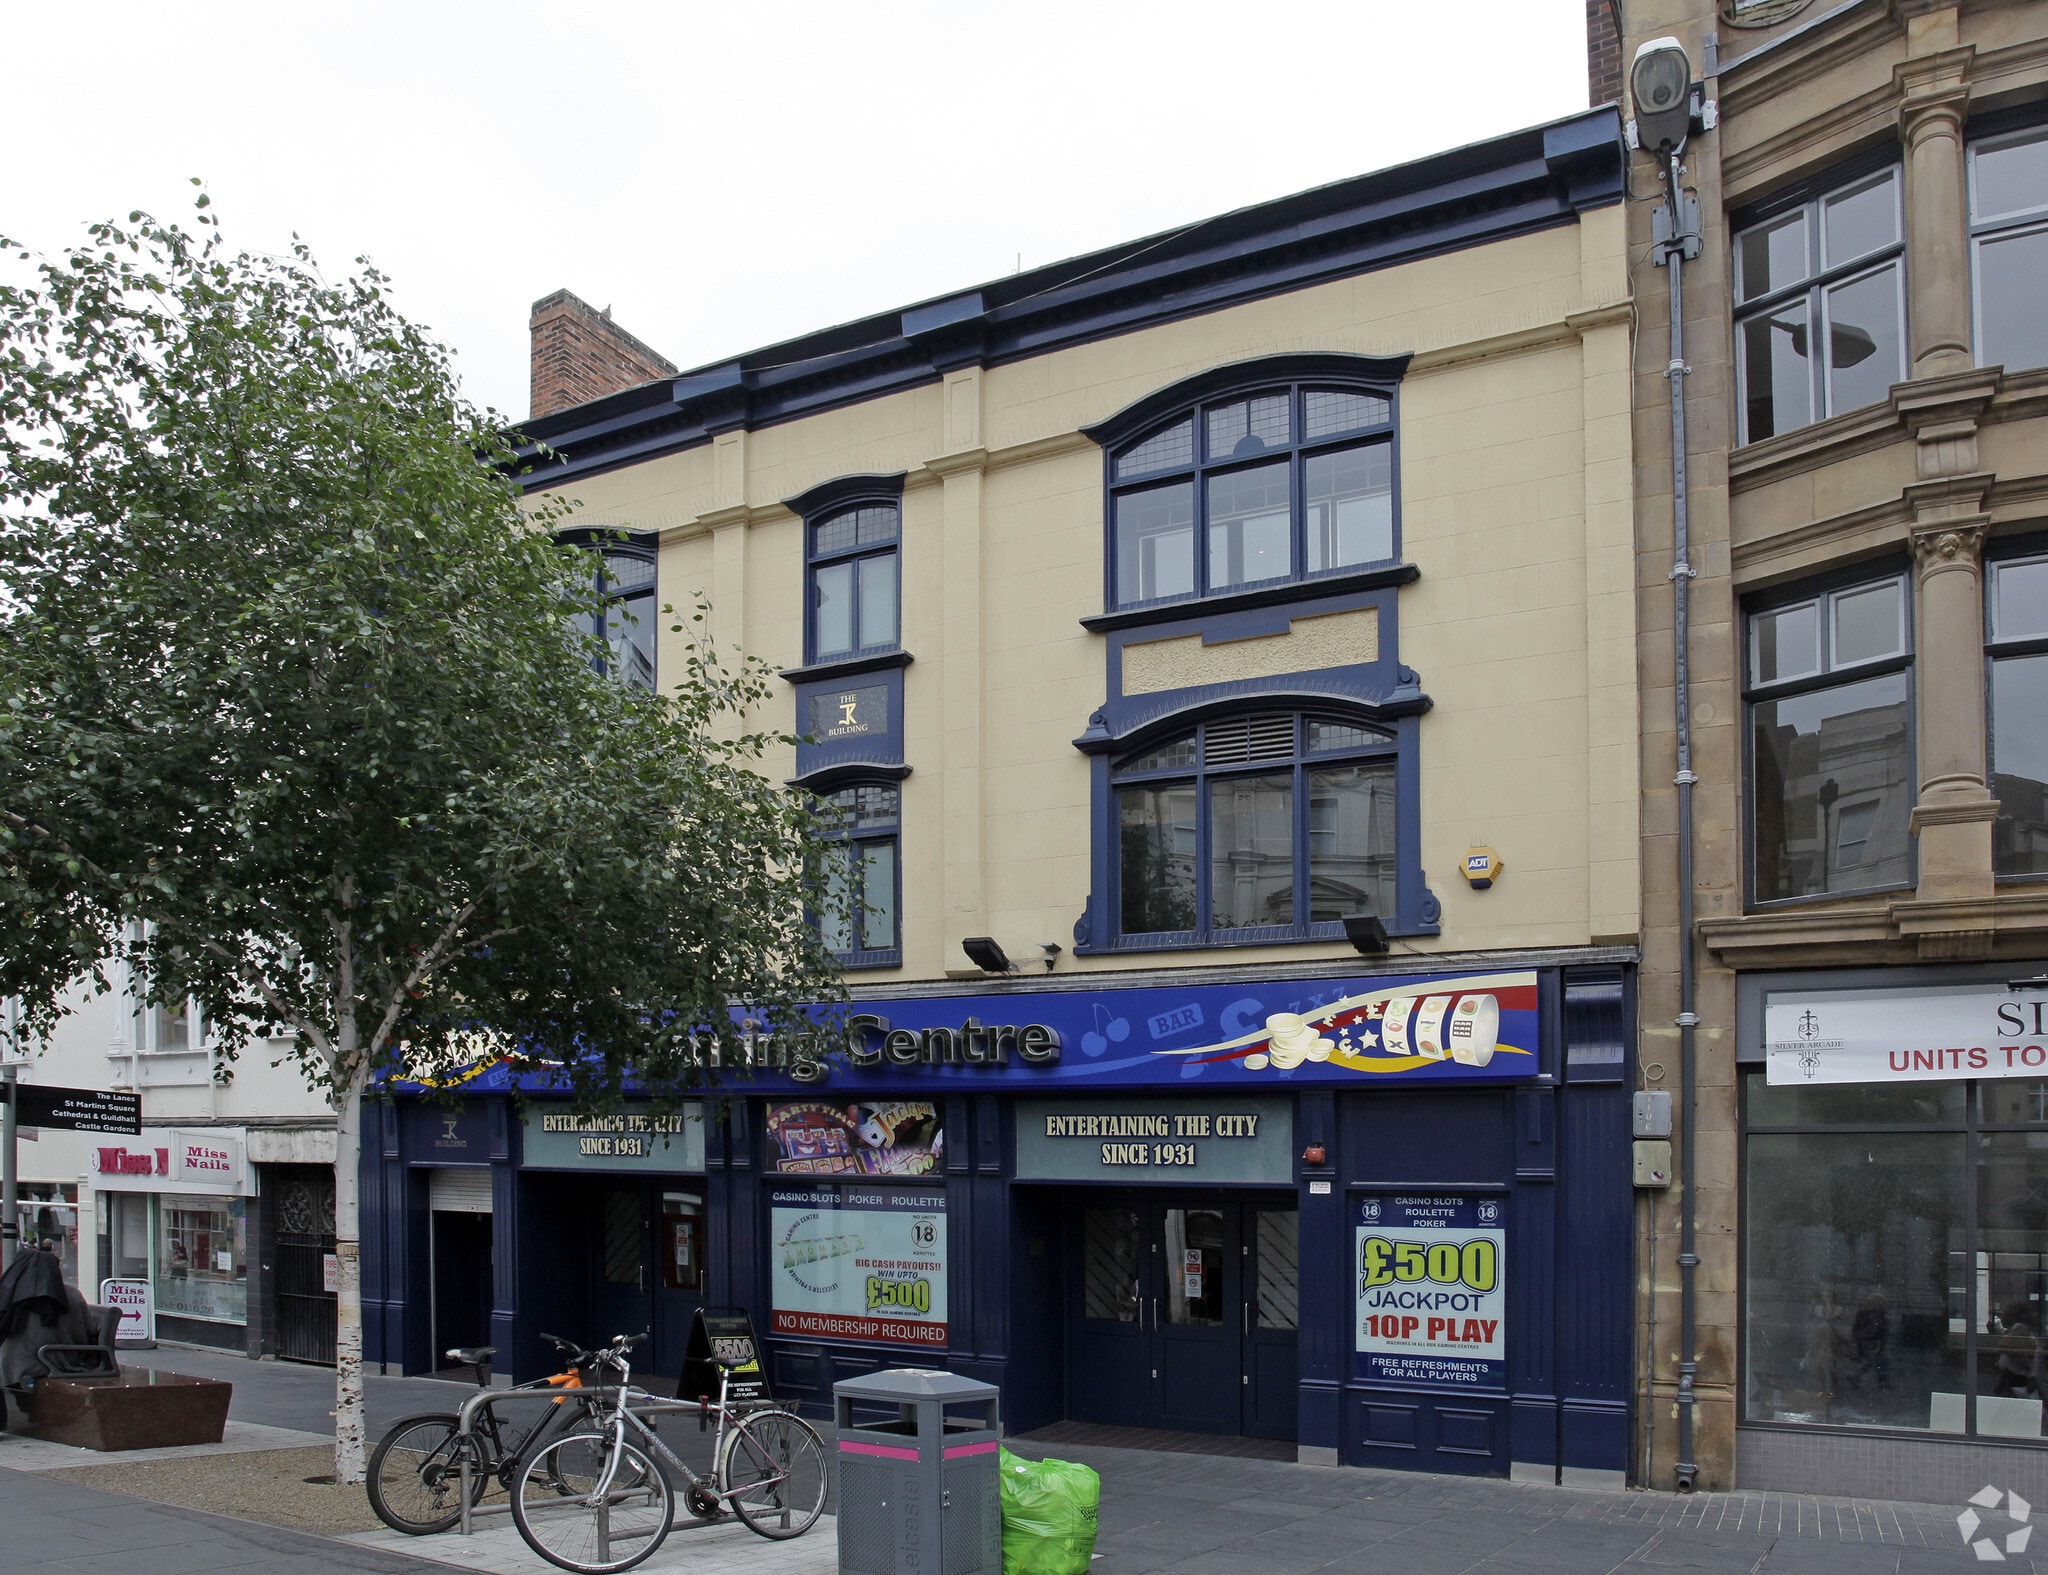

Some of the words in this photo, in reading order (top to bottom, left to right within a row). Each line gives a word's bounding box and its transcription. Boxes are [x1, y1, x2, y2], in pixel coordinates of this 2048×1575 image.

[840, 694, 857, 703] THE
[828, 724, 868, 736] BUILDING
[1468, 858, 1488, 868] ADT
[1154, 1007, 1199, 1035] BAR
[847, 1013, 1061, 1067] Centre
[1775, 1042, 1805, 1050] SILVER
[1806, 1040, 1844, 1049] ARCADE
[1889, 1047, 1988, 1071] UNITS
[1999, 1045, 2047, 1068] TO
[96, 1092, 111, 1100] The
[113, 1093, 136, 1102] Lanes
[76, 1101, 106, 1110] Martins
[108, 1103, 136, 1113] Square
[52, 1109, 91, 1119] Cathedral
[101, 1114, 136, 1123] Guildhall
[75, 1122, 101, 1130] Castle
[103, 1124, 136, 1133] Gardens
[1045, 1116, 1169, 1137] ENTERTAINING
[1174, 1116, 1210, 1136] THE
[1215, 1115, 1258, 1137] CITY
[187, 1146, 228, 1160] Miss
[579, 1137, 611, 1155] SINCE
[613, 1138, 642, 1156] 1931
[1101, 1143, 1148, 1165] SINCE
[1153, 1144, 1196, 1165] 1931
[97, 1147, 153, 1175] Miss
[185, 1157, 230, 1171] Nails
[772, 1192, 809, 1202] CASINO
[810, 1193, 841, 1203] SLOTS
[849, 1195, 883, 1205] POKER
[891, 1196, 946, 1207] ROULETTE
[1395, 1197, 1431, 1206] CASINO
[1433, 1198, 1464, 1206] SLOTS
[1364, 1205, 1378, 1216] 18
[1405, 1208, 1456, 1217] ROULETTE
[1481, 1207, 1495, 1218] 18
[785, 1219, 801, 1242] GAMING
[1413, 1219, 1446, 1228] POKER
[914, 1225, 934, 1243] 18
[855, 1259, 870, 1268] BIG
[872, 1260, 895, 1269] CASH
[897, 1261, 941, 1272] PAYOUTS!!
[1362, 1236, 1498, 1294] £500
[877, 1269, 896, 1278] WIN
[897, 1270, 918, 1279] UPTO
[110, 1285, 145, 1295] Miss
[866, 1277, 931, 1313] £500
[107, 1295, 146, 1304] Nails
[1368, 1290, 1485, 1312] JACKPOT
[778, 1314, 797, 1329] NO
[799, 1316, 879, 1336] MEMBERSHIP
[882, 1323, 945, 1341] REQUIRED
[1366, 1314, 1419, 1339] 10P
[1427, 1317, 1499, 1344] PLAY
[714, 1338, 755, 1359] £500
[1372, 1357, 1399, 1367] FREE
[1401, 1359, 1489, 1373] REFRESHMENTS
[1382, 1367, 1404, 1377] FOR
[1407, 1369, 1426, 1379] ALL
[1428, 1370, 1478, 1382] PLAYERS
[901, 1469, 920, 1575] eicester
[985, 1460, 1001, 1569] Leicester
